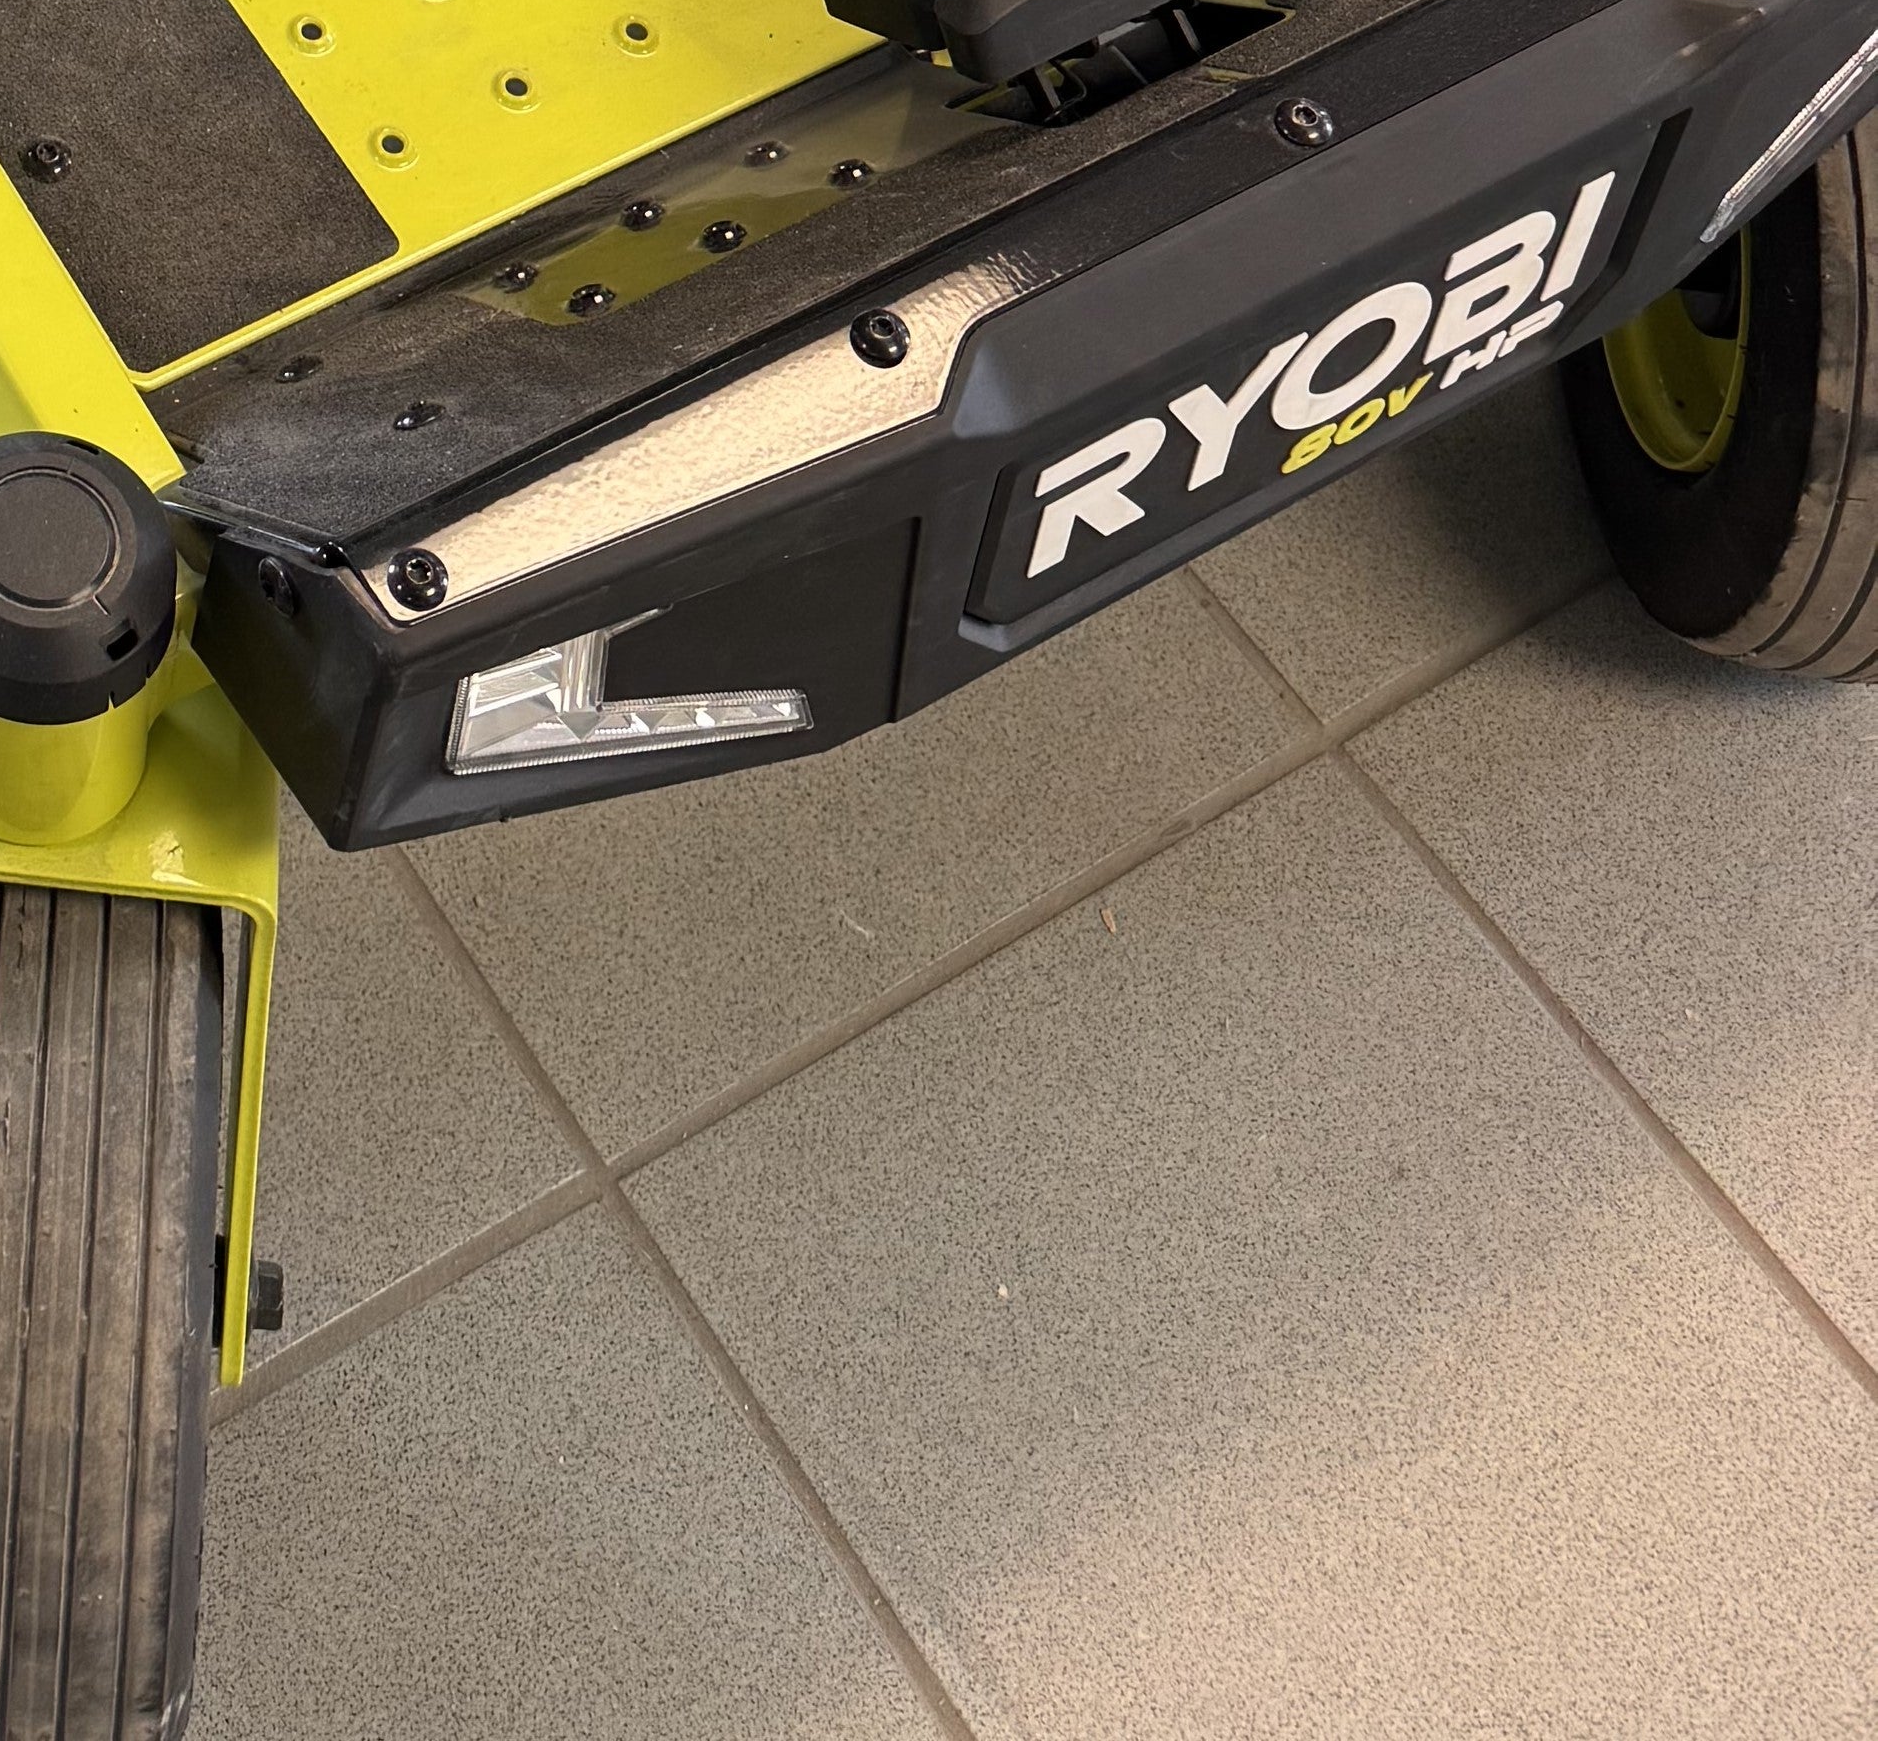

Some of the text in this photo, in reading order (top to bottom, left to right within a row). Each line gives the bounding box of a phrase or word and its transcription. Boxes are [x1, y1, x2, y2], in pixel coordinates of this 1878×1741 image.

[1026, 171, 1616, 579] RYOBI
[1281, 299, 1565, 474] 80V HP
